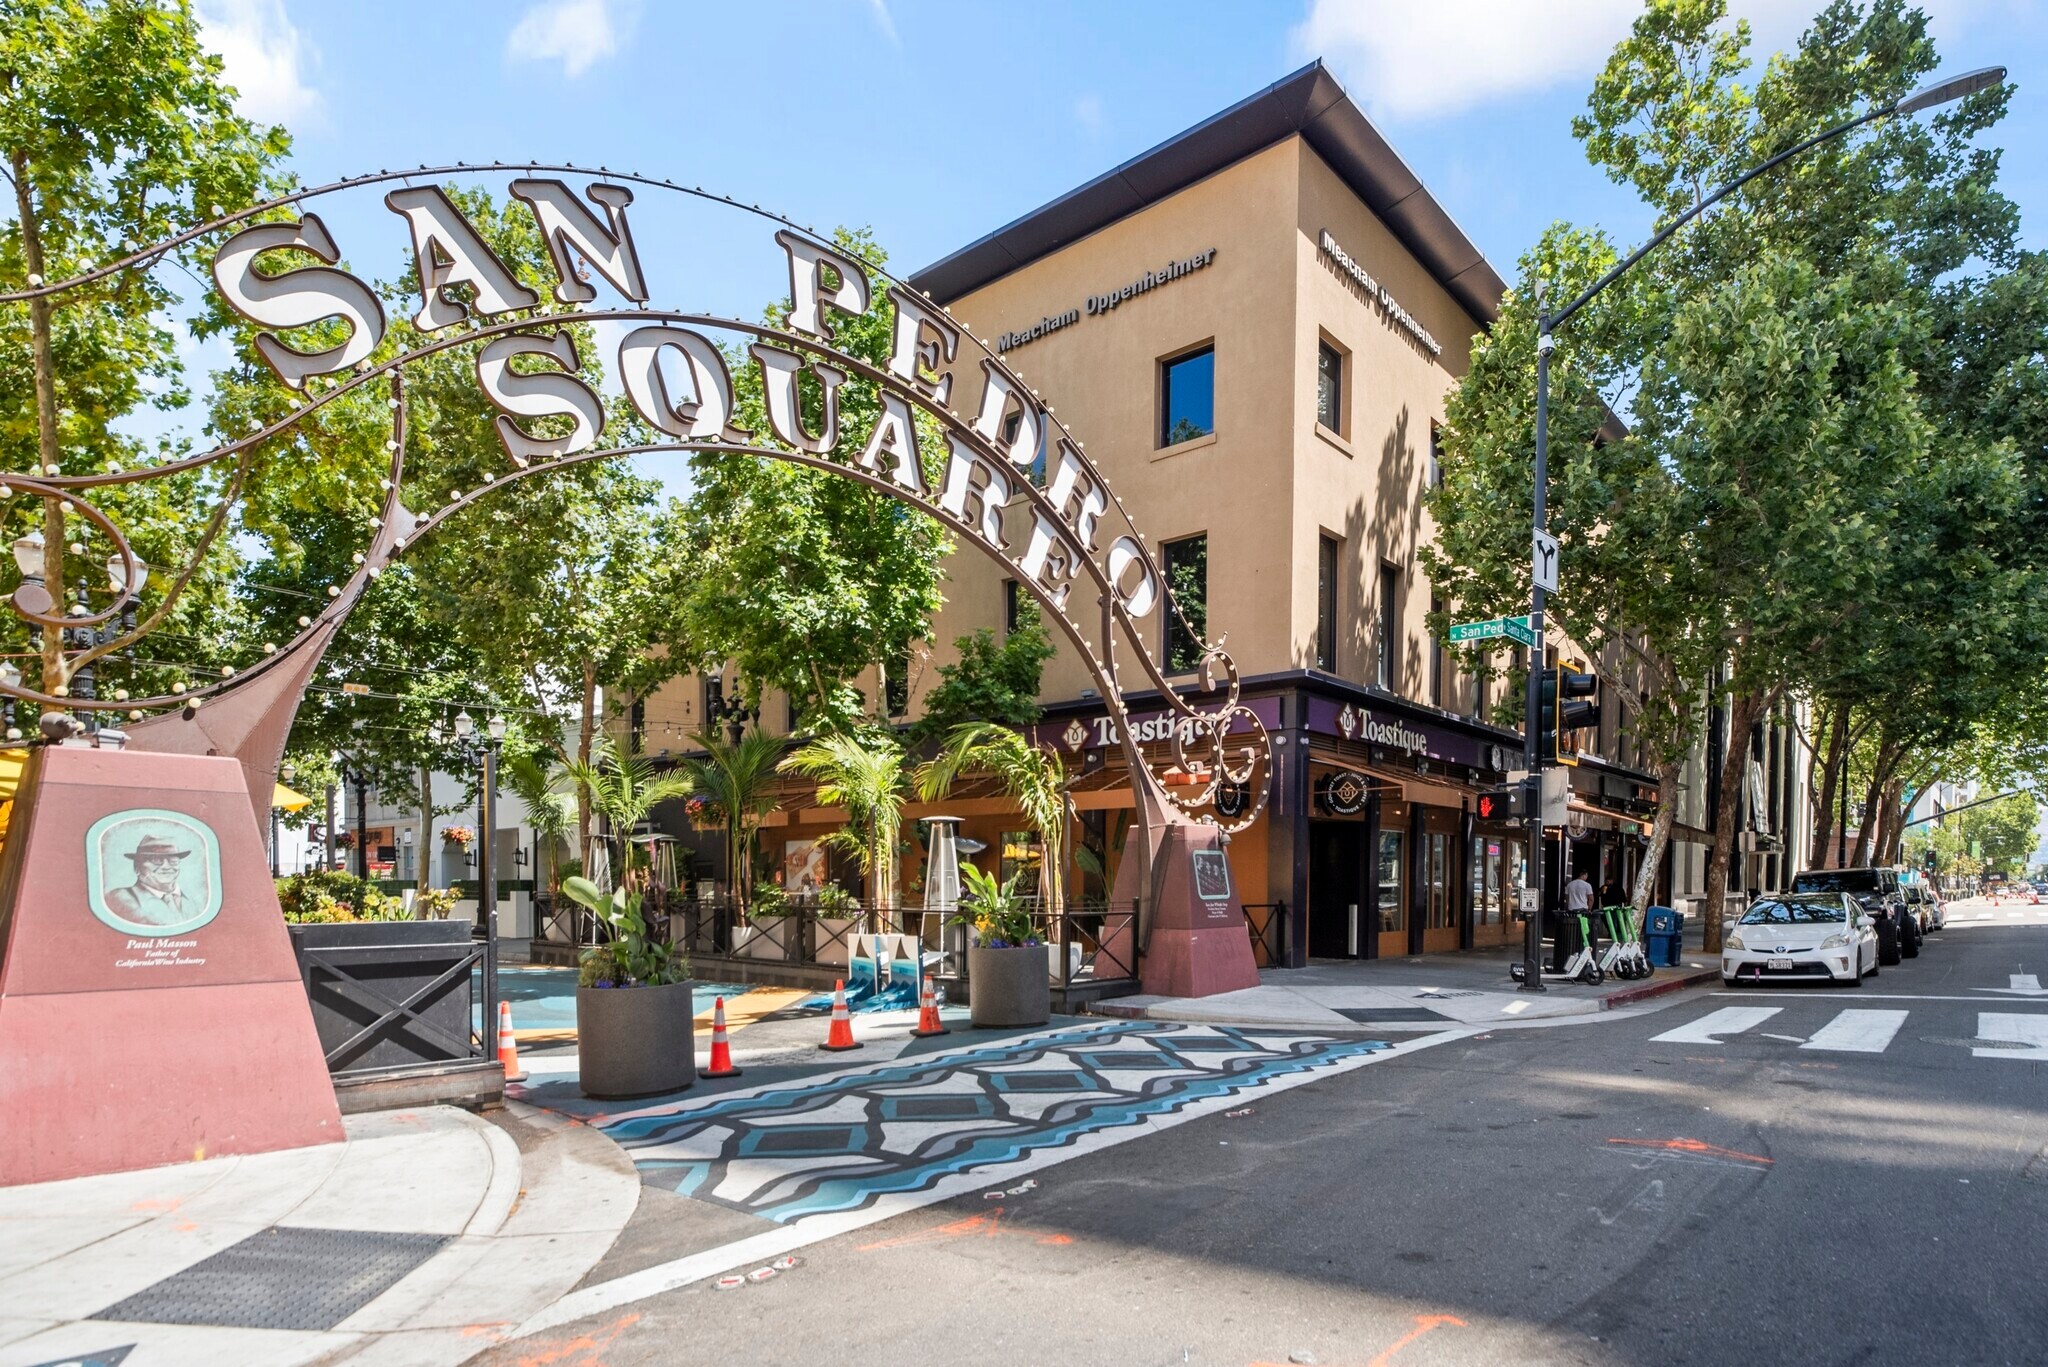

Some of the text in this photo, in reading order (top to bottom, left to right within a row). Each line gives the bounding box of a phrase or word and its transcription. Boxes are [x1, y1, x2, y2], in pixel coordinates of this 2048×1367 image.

[1320, 228, 1378, 296] Meacham
[995, 247, 1217, 353] Meacham Oppenheimer
[212, 178, 1160, 619] SAN PEDRO
[477, 325, 1081, 606] SQUARE
[1460, 627, 1480, 638] San
[1483, 623, 1504, 635] Ped
[1358, 708, 1427, 757] Toastique
[115, 957, 206, 968] California Wine Industry
[126, 938, 154, 949] Paul
[145, 949, 180, 958] Father of
